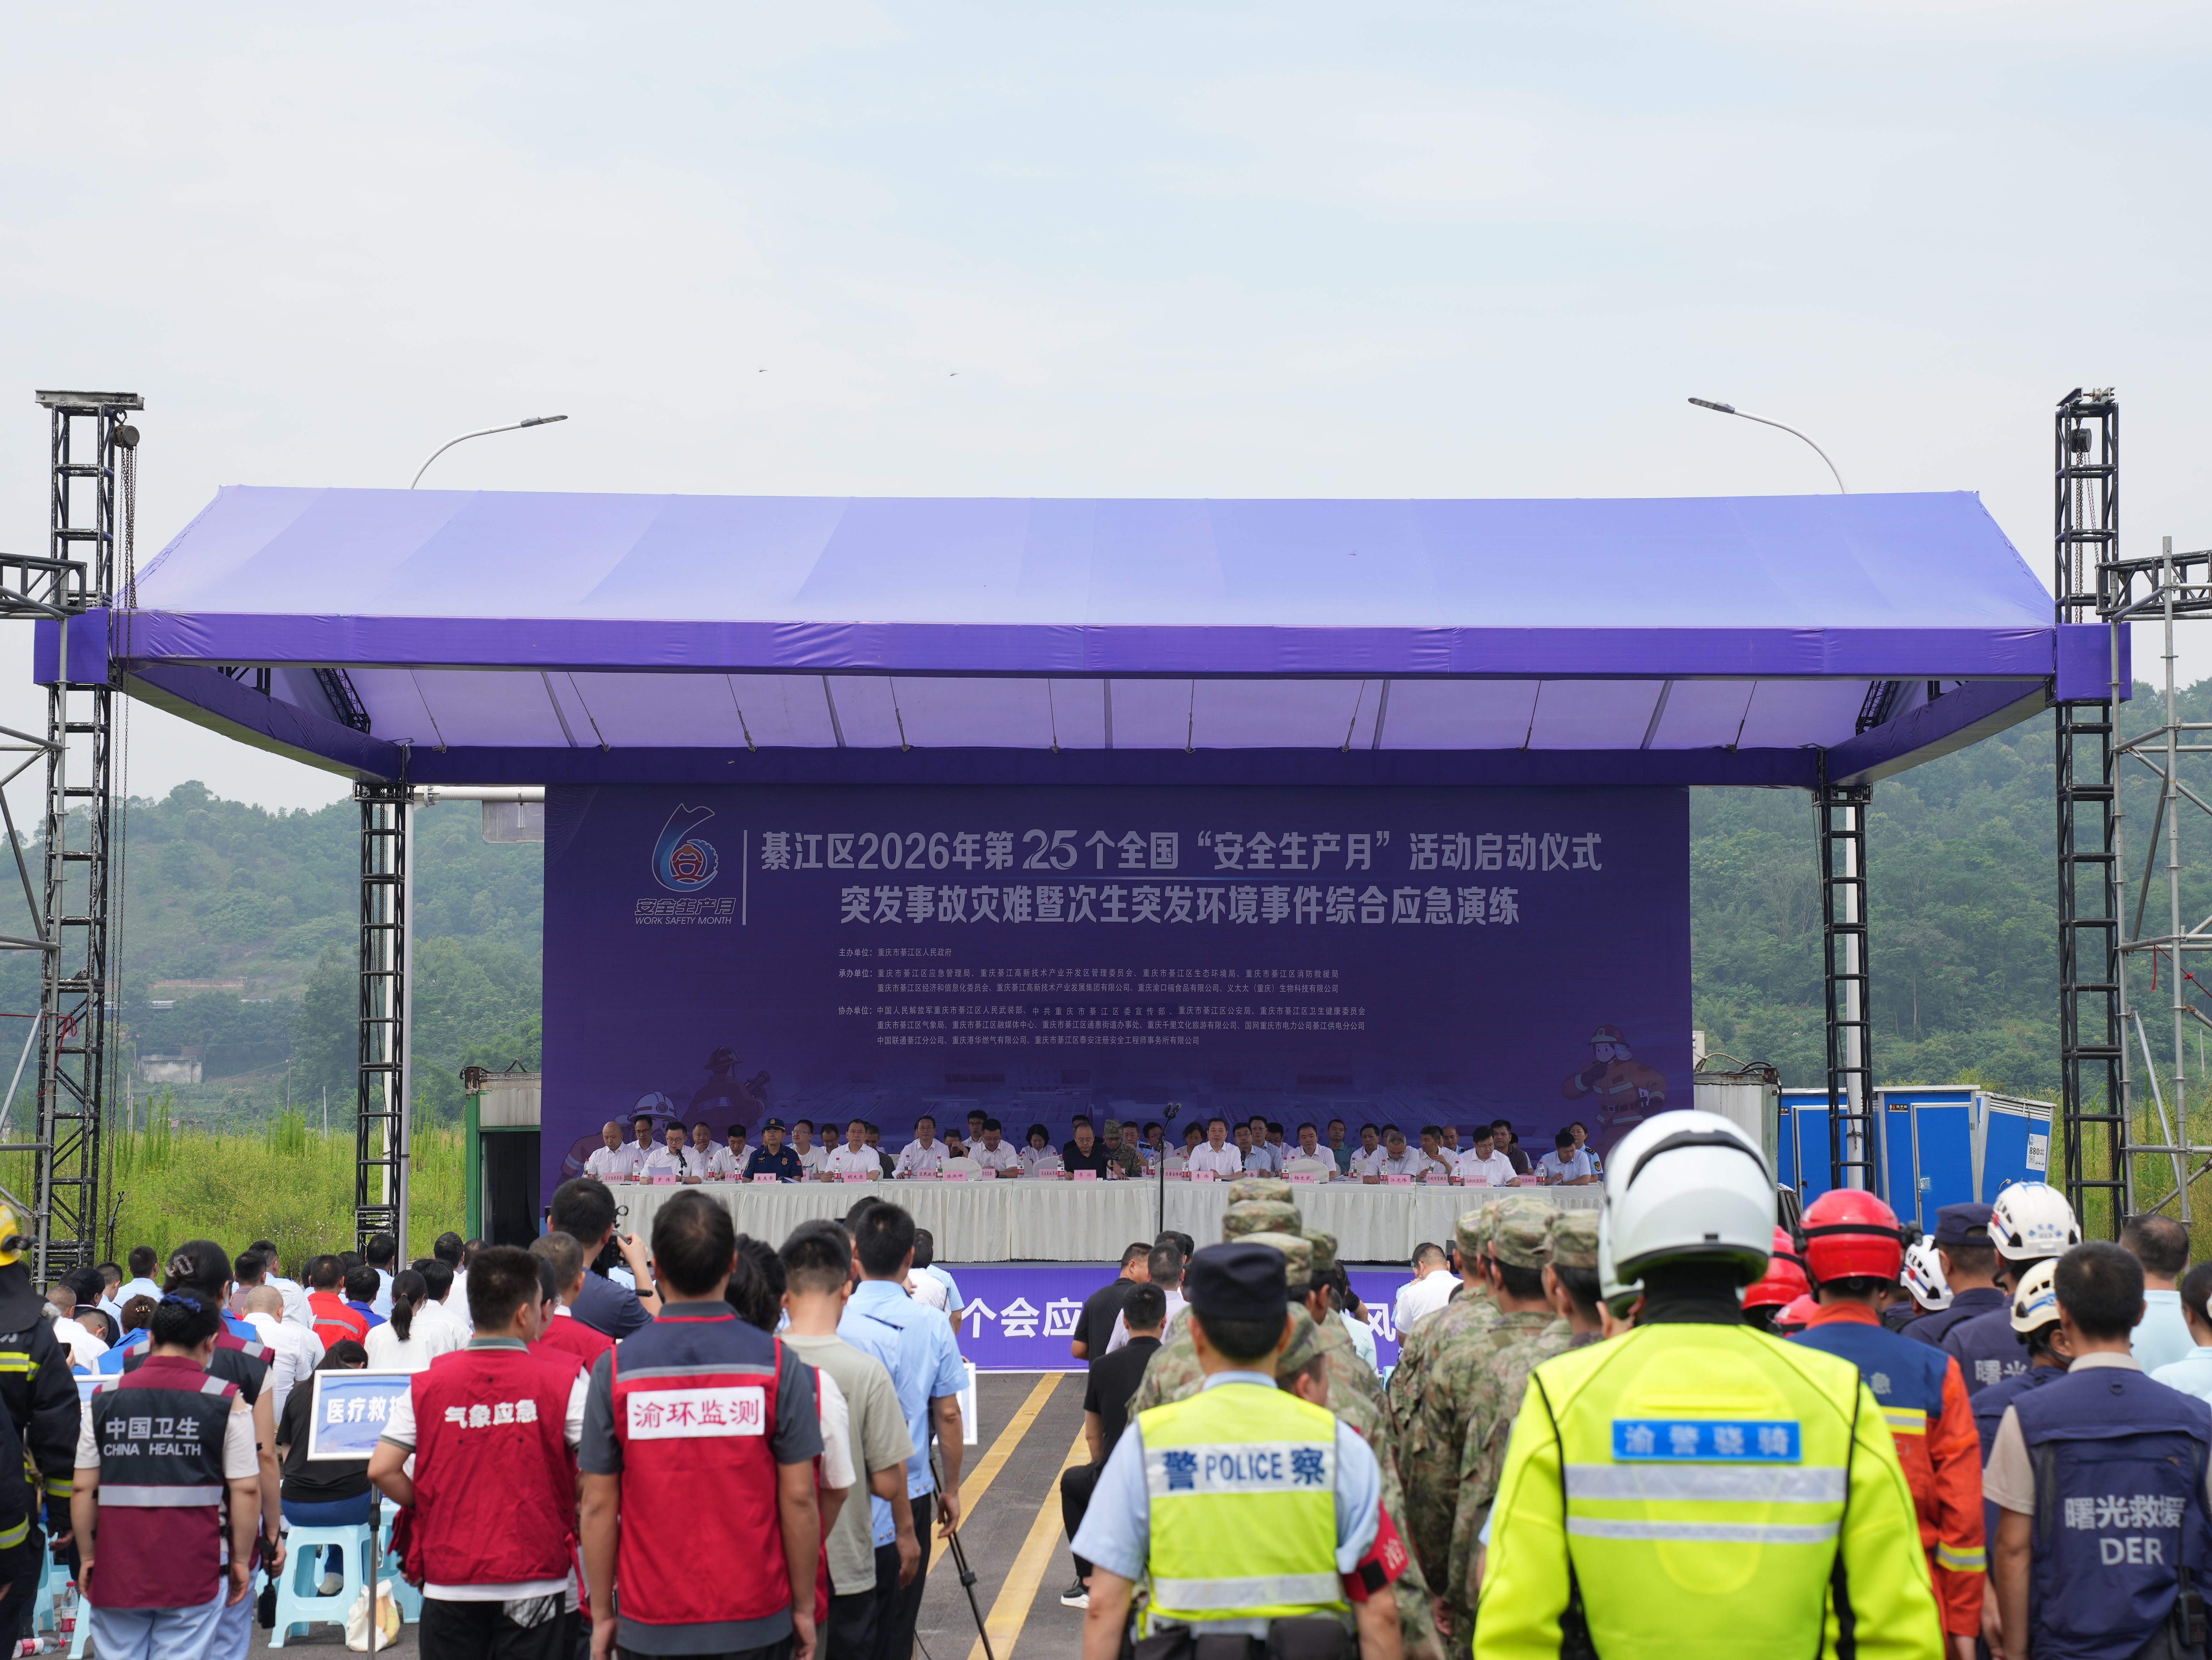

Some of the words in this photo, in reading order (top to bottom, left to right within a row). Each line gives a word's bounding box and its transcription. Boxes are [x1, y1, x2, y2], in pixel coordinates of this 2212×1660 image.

[634, 898, 736, 916] 安全生产月
[841, 885, 1519, 926] 突发事故灾难暨次生突发环境事件综合应急演练
[665, 916, 696, 925] SAFETY
[698, 916, 732, 925] MONTH
[877, 948, 952, 957] 重庆市綦江区人民政府
[2029, 1147, 2040, 1155] 880
[961, 1297, 1083, 1338] 个会应
[106, 1416, 200, 1440] 中国卫生
[444, 1399, 538, 1429] 气象应急
[634, 1399, 759, 1428] 渝环监测
[103, 1443, 140, 1456] CHINA
[149, 1443, 201, 1456] HEALTH
[1162, 1450, 1198, 1490] 警
[1206, 1452, 1283, 1481] POLICE
[1291, 1447, 1325, 1484] 察
[2064, 1494, 2187, 1530] 曙光救援
[2099, 1536, 2165, 1565] DER
